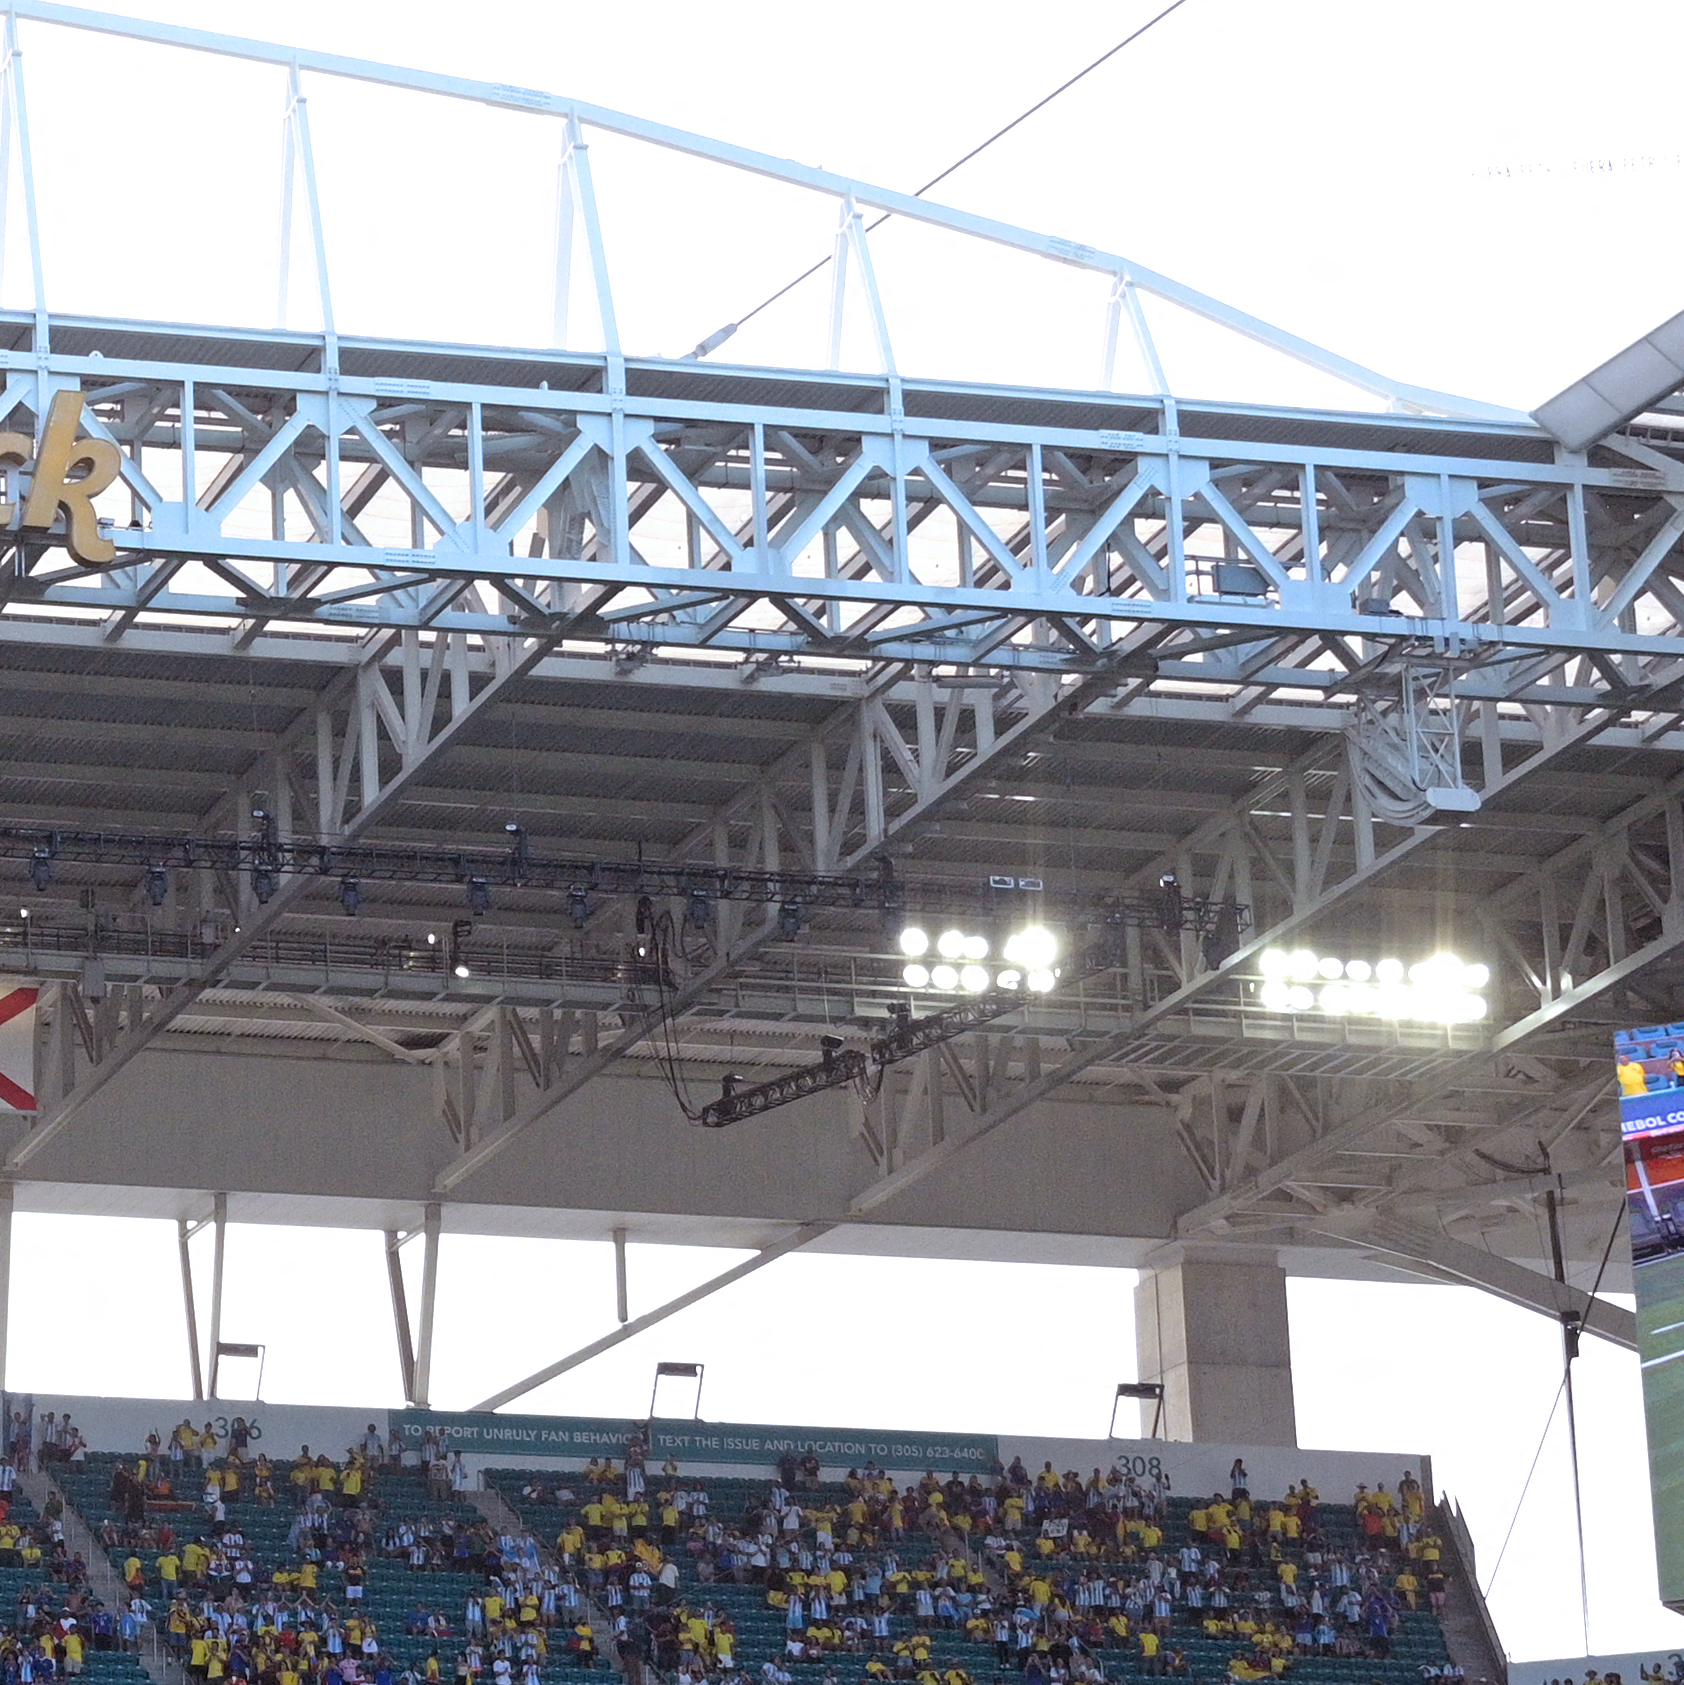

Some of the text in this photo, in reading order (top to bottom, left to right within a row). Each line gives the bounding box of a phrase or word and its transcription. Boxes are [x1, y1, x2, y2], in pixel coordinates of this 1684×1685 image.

[403, 1424, 422, 1436] TO
[483, 1428, 538, 1441] UNRULY
[541, 1430, 569, 1442] FAN
[658, 1435, 690, 1447] TEXT
[694, 1436, 720, 1448] THE
[723, 1438, 760, 1450] ISSUE
[765, 1439, 796, 1450] AND
[799, 1441, 865, 1454] LOCATION
[869, 1444, 887, 1455] TO
[892, 1444, 922, 1458] (305)
[1117, 1455, 1162, 1478] 308
